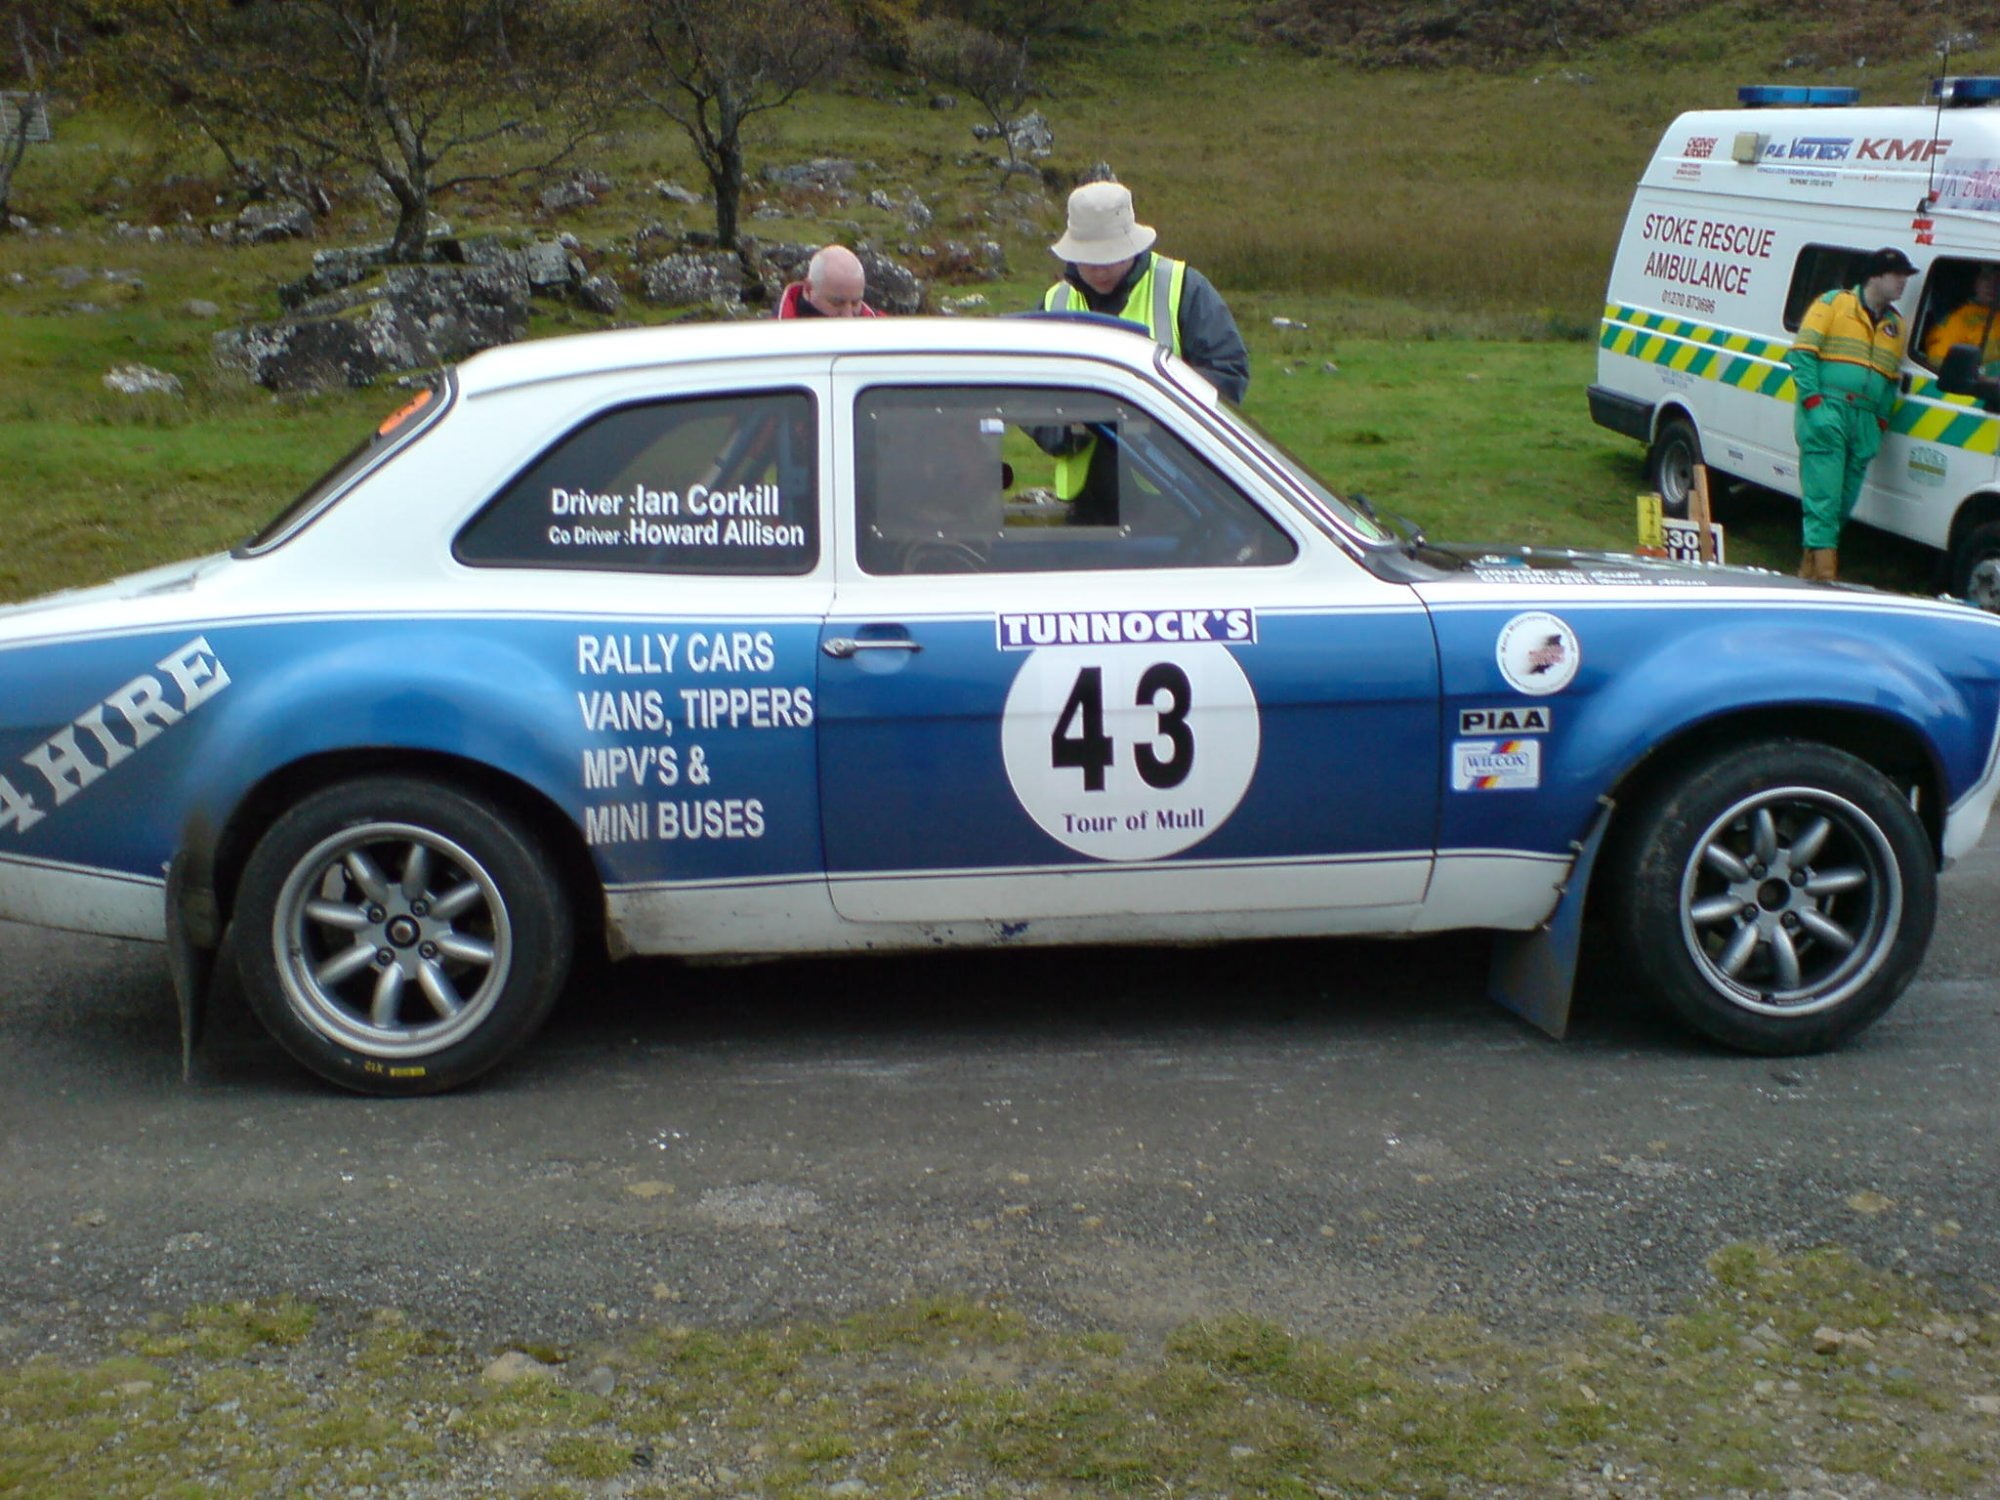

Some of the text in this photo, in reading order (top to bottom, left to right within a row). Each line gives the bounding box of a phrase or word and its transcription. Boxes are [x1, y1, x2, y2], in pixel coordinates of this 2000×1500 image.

[1856, 138, 1953, 161] KMF
[1643, 213, 1776, 258] STOKE RESCUE
[1644, 251, 1751, 295] AMBULANCE
[552, 488, 623, 516] Driver
[687, 484, 779, 516] Corkill
[549, 525, 570, 545] Co
[574, 526, 621, 545] Driver
[723, 518, 805, 546] Allison
[1003, 609, 1250, 645] TUNNOCK'S
[578, 631, 775, 675] RALLY CARS
[21, 635, 232, 808] HIRE
[578, 686, 814, 737] VANS, TIPPERS
[1052, 661, 1195, 792] 43
[1462, 710, 1545, 731] PIAA
[583, 744, 711, 789] MPV'S &
[585, 799, 765, 846] MINI BUSES
[1062, 808, 1205, 834] Tour of Mull
